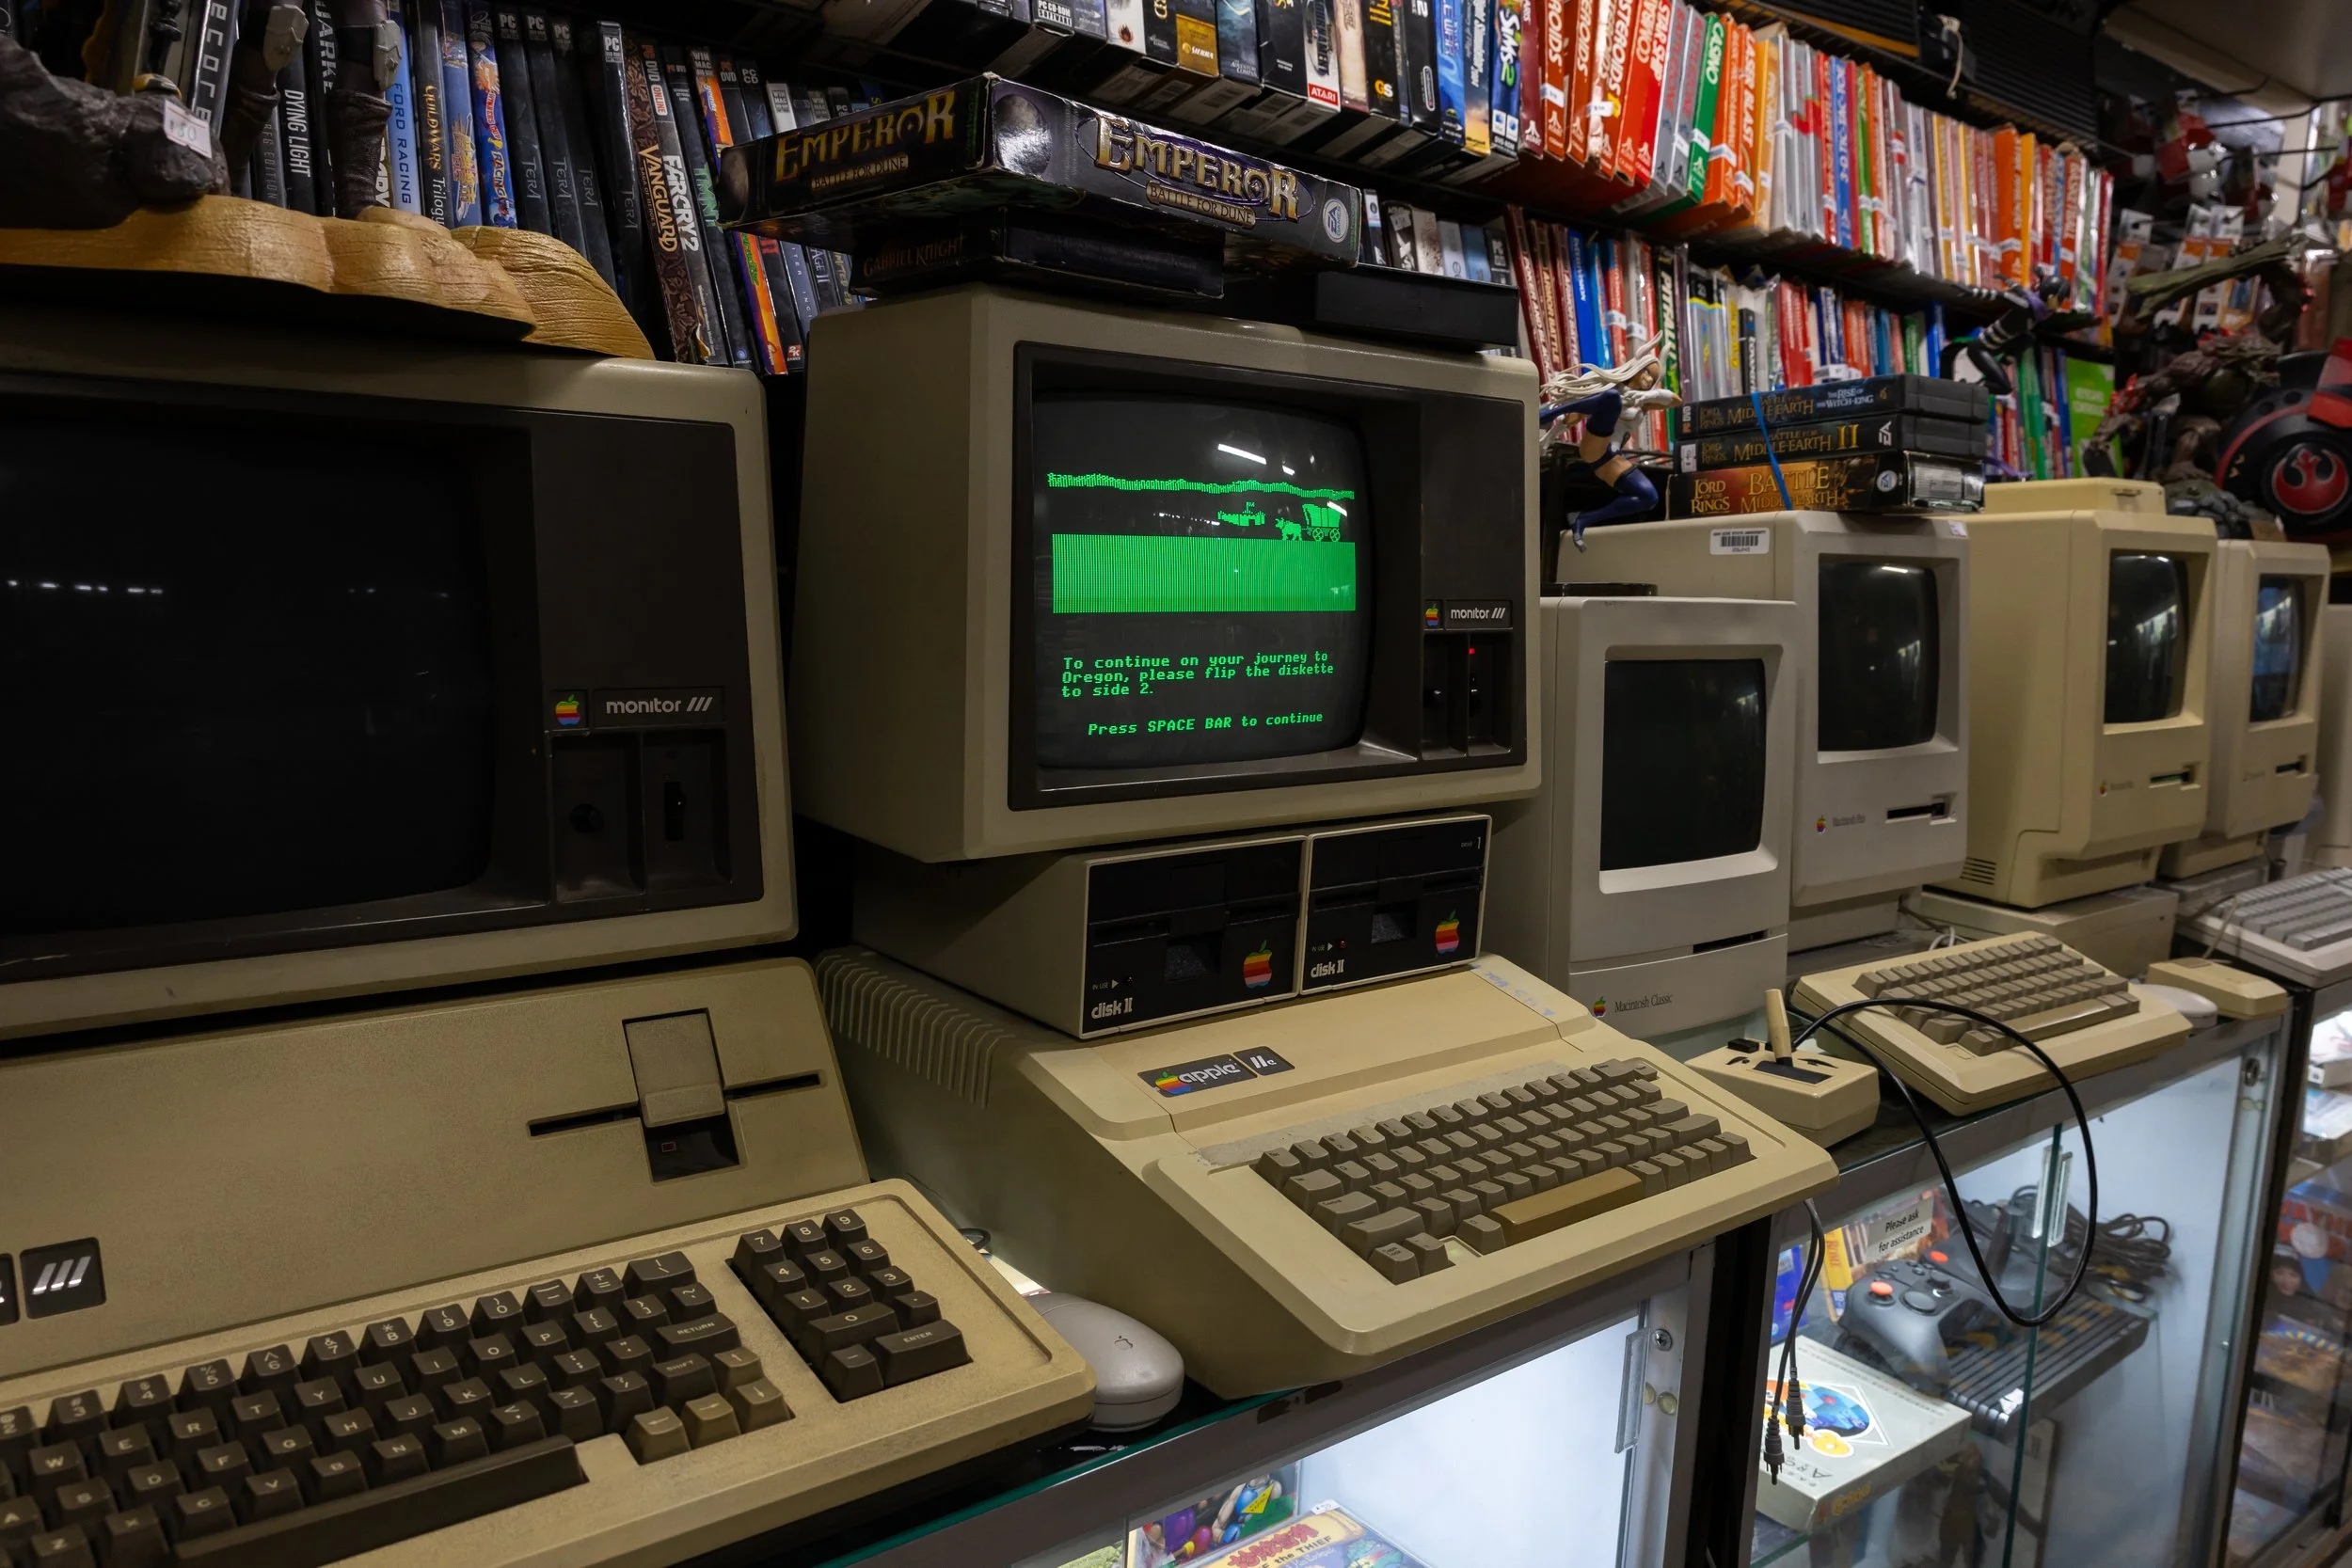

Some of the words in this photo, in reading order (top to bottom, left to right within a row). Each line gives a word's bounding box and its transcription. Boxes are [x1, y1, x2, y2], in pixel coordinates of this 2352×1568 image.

[1048, 2, 1071, 17] CD-ROM
[500, 13, 516, 28] PC
[527, 15, 544, 31] PC
[605, 35, 620, 52] PC
[1191, 45, 1215, 60] SIERRA
[1706, 22, 1725, 86] CASINO
[1745, 33, 1756, 87] LASER
[645, 60, 660, 81] DVD
[720, 71, 738, 83] DVD
[742, 69, 757, 77] PC
[743, 76, 759, 85] CD
[1374, 78, 1395, 99] GS
[652, 86, 667, 115] ONLINE
[1311, 86, 1337, 103] ATARI
[285, 89, 307, 133] DYING
[394, 83, 405, 130] FORD
[1742, 90, 1755, 148] BLAST
[774, 89, 957, 182] EMPEROR
[288, 138, 310, 178] LIGHT
[397, 139, 412, 204] RACING
[490, 150, 507, 201] RACING
[814, 169, 849, 189] BATTLE
[851, 165, 872, 180] FOR
[873, 155, 908, 173] DUNE
[1094, 115, 1299, 224] EMPEROR
[430, 177, 446, 226] Trilogy
[637, 144, 678, 252] VANGUARD
[1151, 185, 1192, 208] BATTLE
[1195, 197, 1218, 214] FOR
[1220, 204, 1253, 225] DUNE
[864, 248, 914, 277] GABRIEL
[1563, 273, 1575, 315] ARMOR
[1542, 269, 1554, 310] ARMOR
[1549, 313, 1561, 362] BATTLE
[1837, 388, 1857, 400] RISE
[1837, 422, 1861, 451] II
[1693, 479, 1727, 499] LORD
[1691, 496, 1732, 514] RINGS
[1450, 607, 1491, 620] monitor
[1064, 657, 1084, 671] To
[1094, 655, 1170, 669] continue
[1181, 656, 1200, 667] on
[1209, 654, 1245, 667] your
[1254, 651, 1308, 666] journey
[1314, 650, 1328, 662] to
[1062, 671, 1130, 685] Oregon,
[1139, 668, 1196, 683] please
[1204, 667, 1236, 680] flip
[1246, 665, 1270, 677] the
[1278, 663, 1335, 676] diskette
[1061, 685, 1082, 698] to
[1092, 683, 1130, 697] side
[1139, 683, 1155, 695] 2.
[606, 697, 682, 715] monitor
[1088, 721, 1137, 736] Press
[1147, 718, 1196, 733] SPACE
[1204, 717, 1232, 730] BAR
[1241, 715, 1258, 727] to
[1265, 711, 1324, 726] continue
[1310, 961, 1337, 979] disk
[1091, 999, 1123, 1020] disk
[1614, 995, 1651, 1014] Macintosh
[1650, 993, 1674, 1007] Classic
[1178, 1064, 1242, 1085] apple
[838, 1215, 851, 1226] 9
[1884, 1215, 1908, 1233] Please
[1907, 1208, 1920, 1223] ask
[799, 1227, 812, 1236] 8
[1878, 1241, 1890, 1254] for
[1890, 1225, 1924, 1248] assistance
[754, 1236, 765, 1246] 7
[861, 1245, 874, 1254] 6
[778, 1267, 790, 1276] 4
[883, 1273, 897, 1281] 3
[843, 1283, 857, 1292] 2
[801, 1295, 810, 1305] 1
[844, 1314, 859, 1323] 0
[676, 1321, 716, 1336] RETURN
[902, 1331, 934, 1343] ENTER
[519, 1377, 534, 1386] L
[461, 1389, 477, 1400] K
[407, 1406, 419, 1417] J
[342, 1421, 359, 1433] H
[451, 1426, 469, 1436] M
[282, 1438, 297, 1449] G
[391, 1443, 406, 1453] N
[217, 1455, 230, 1466] F
[147, 1474, 162, 1485] D
[264, 1479, 279, 1489] V
[4, 1513, 21, 1524] A
[51, 1538, 69, 1549] Z
[1274, 1553, 1295, 1565] the
[1295, 1535, 1332, 1556] THIEF
